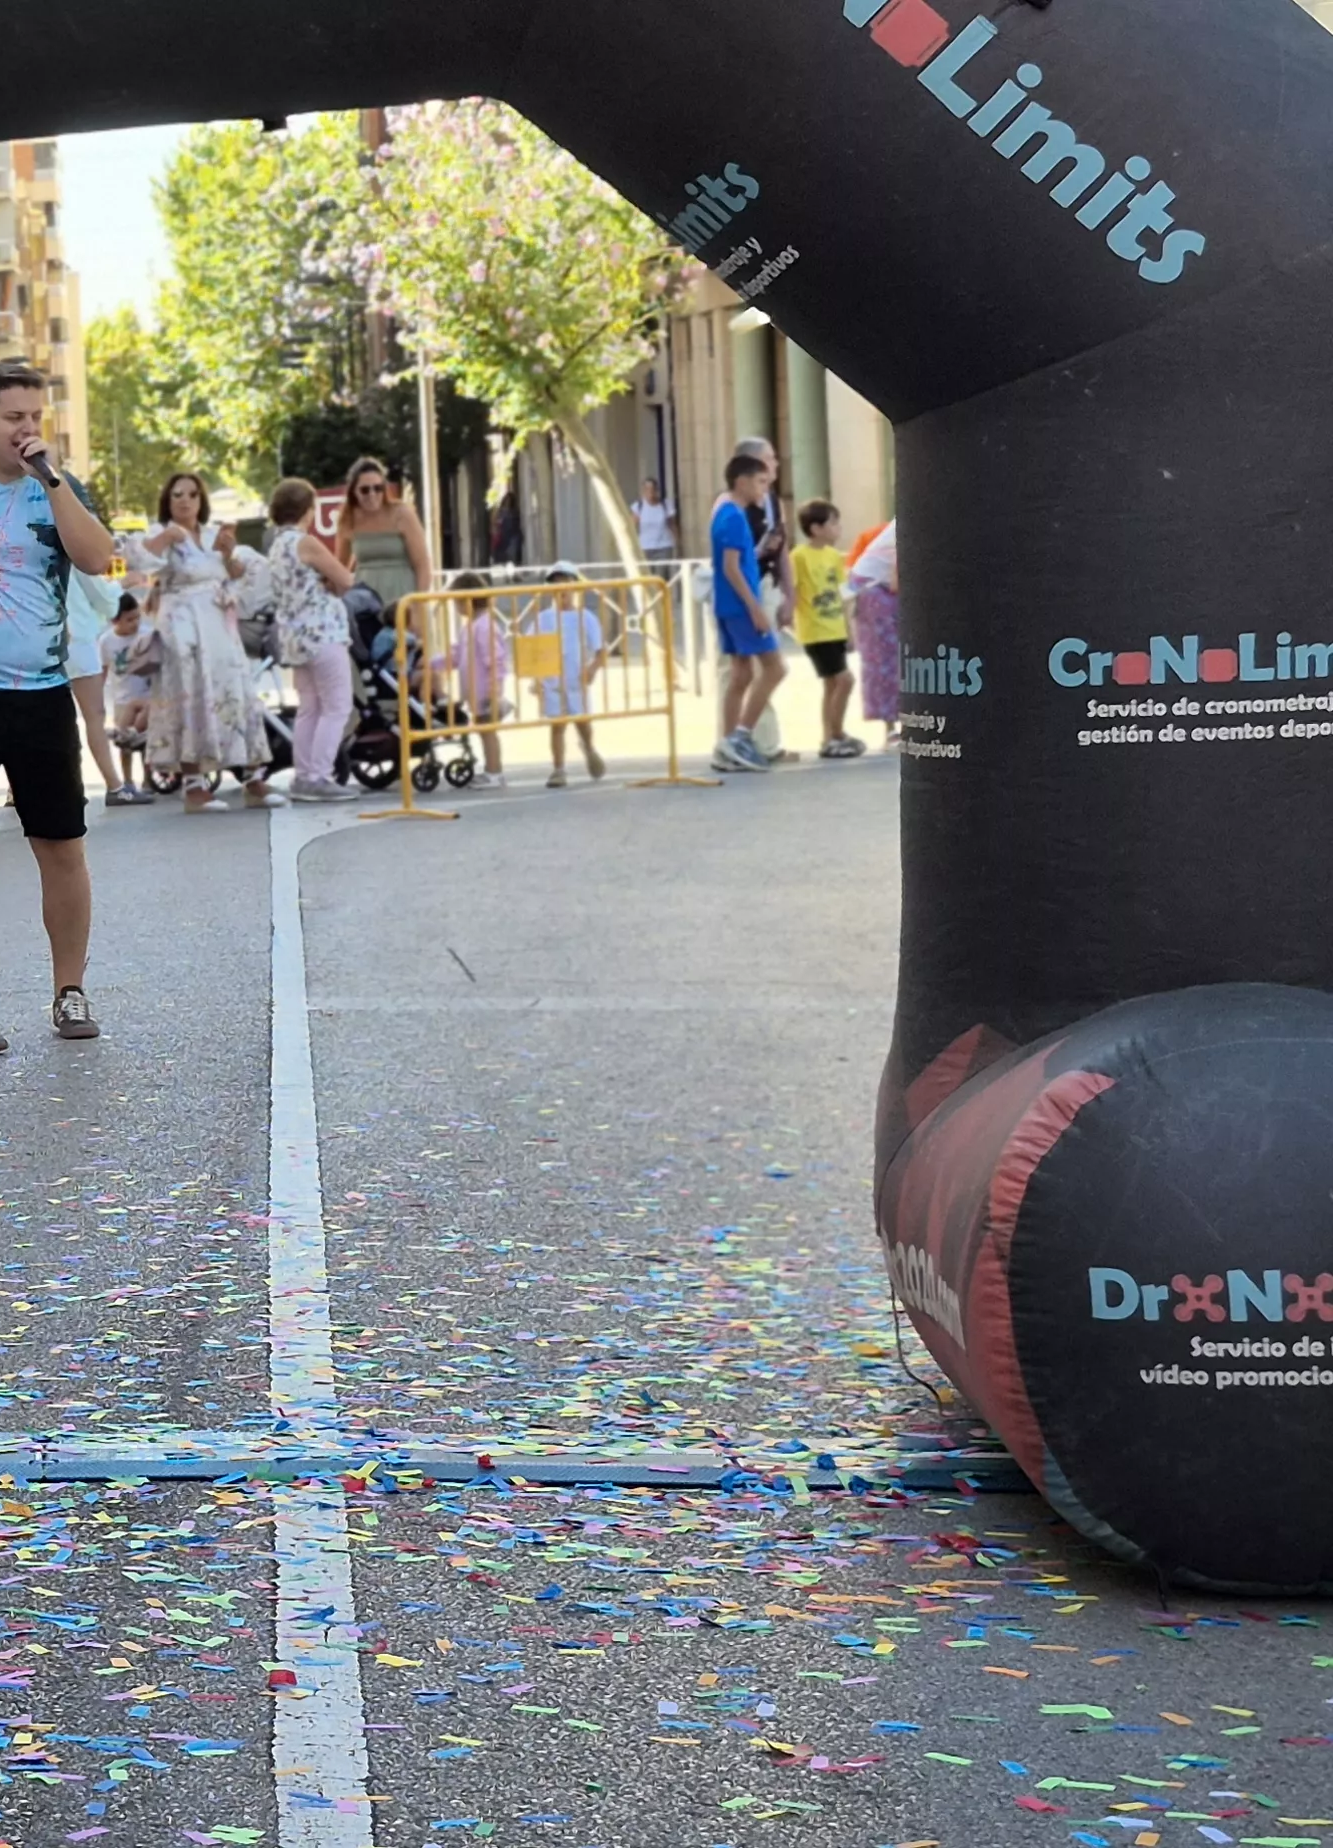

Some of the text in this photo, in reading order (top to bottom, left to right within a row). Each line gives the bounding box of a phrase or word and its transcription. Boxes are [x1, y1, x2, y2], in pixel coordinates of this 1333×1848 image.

[1087, 698, 1167, 718] Servicio
[1171, 697, 1200, 716] de
[936, 716, 946, 734] y
[1077, 724, 1153, 746] gestión
[1158, 723, 1186, 742] de
[1191, 722, 1274, 742] eventos
[1190, 1335, 1325, 1358] Servicio de
[1139, 1364, 1209, 1386] vídeo
